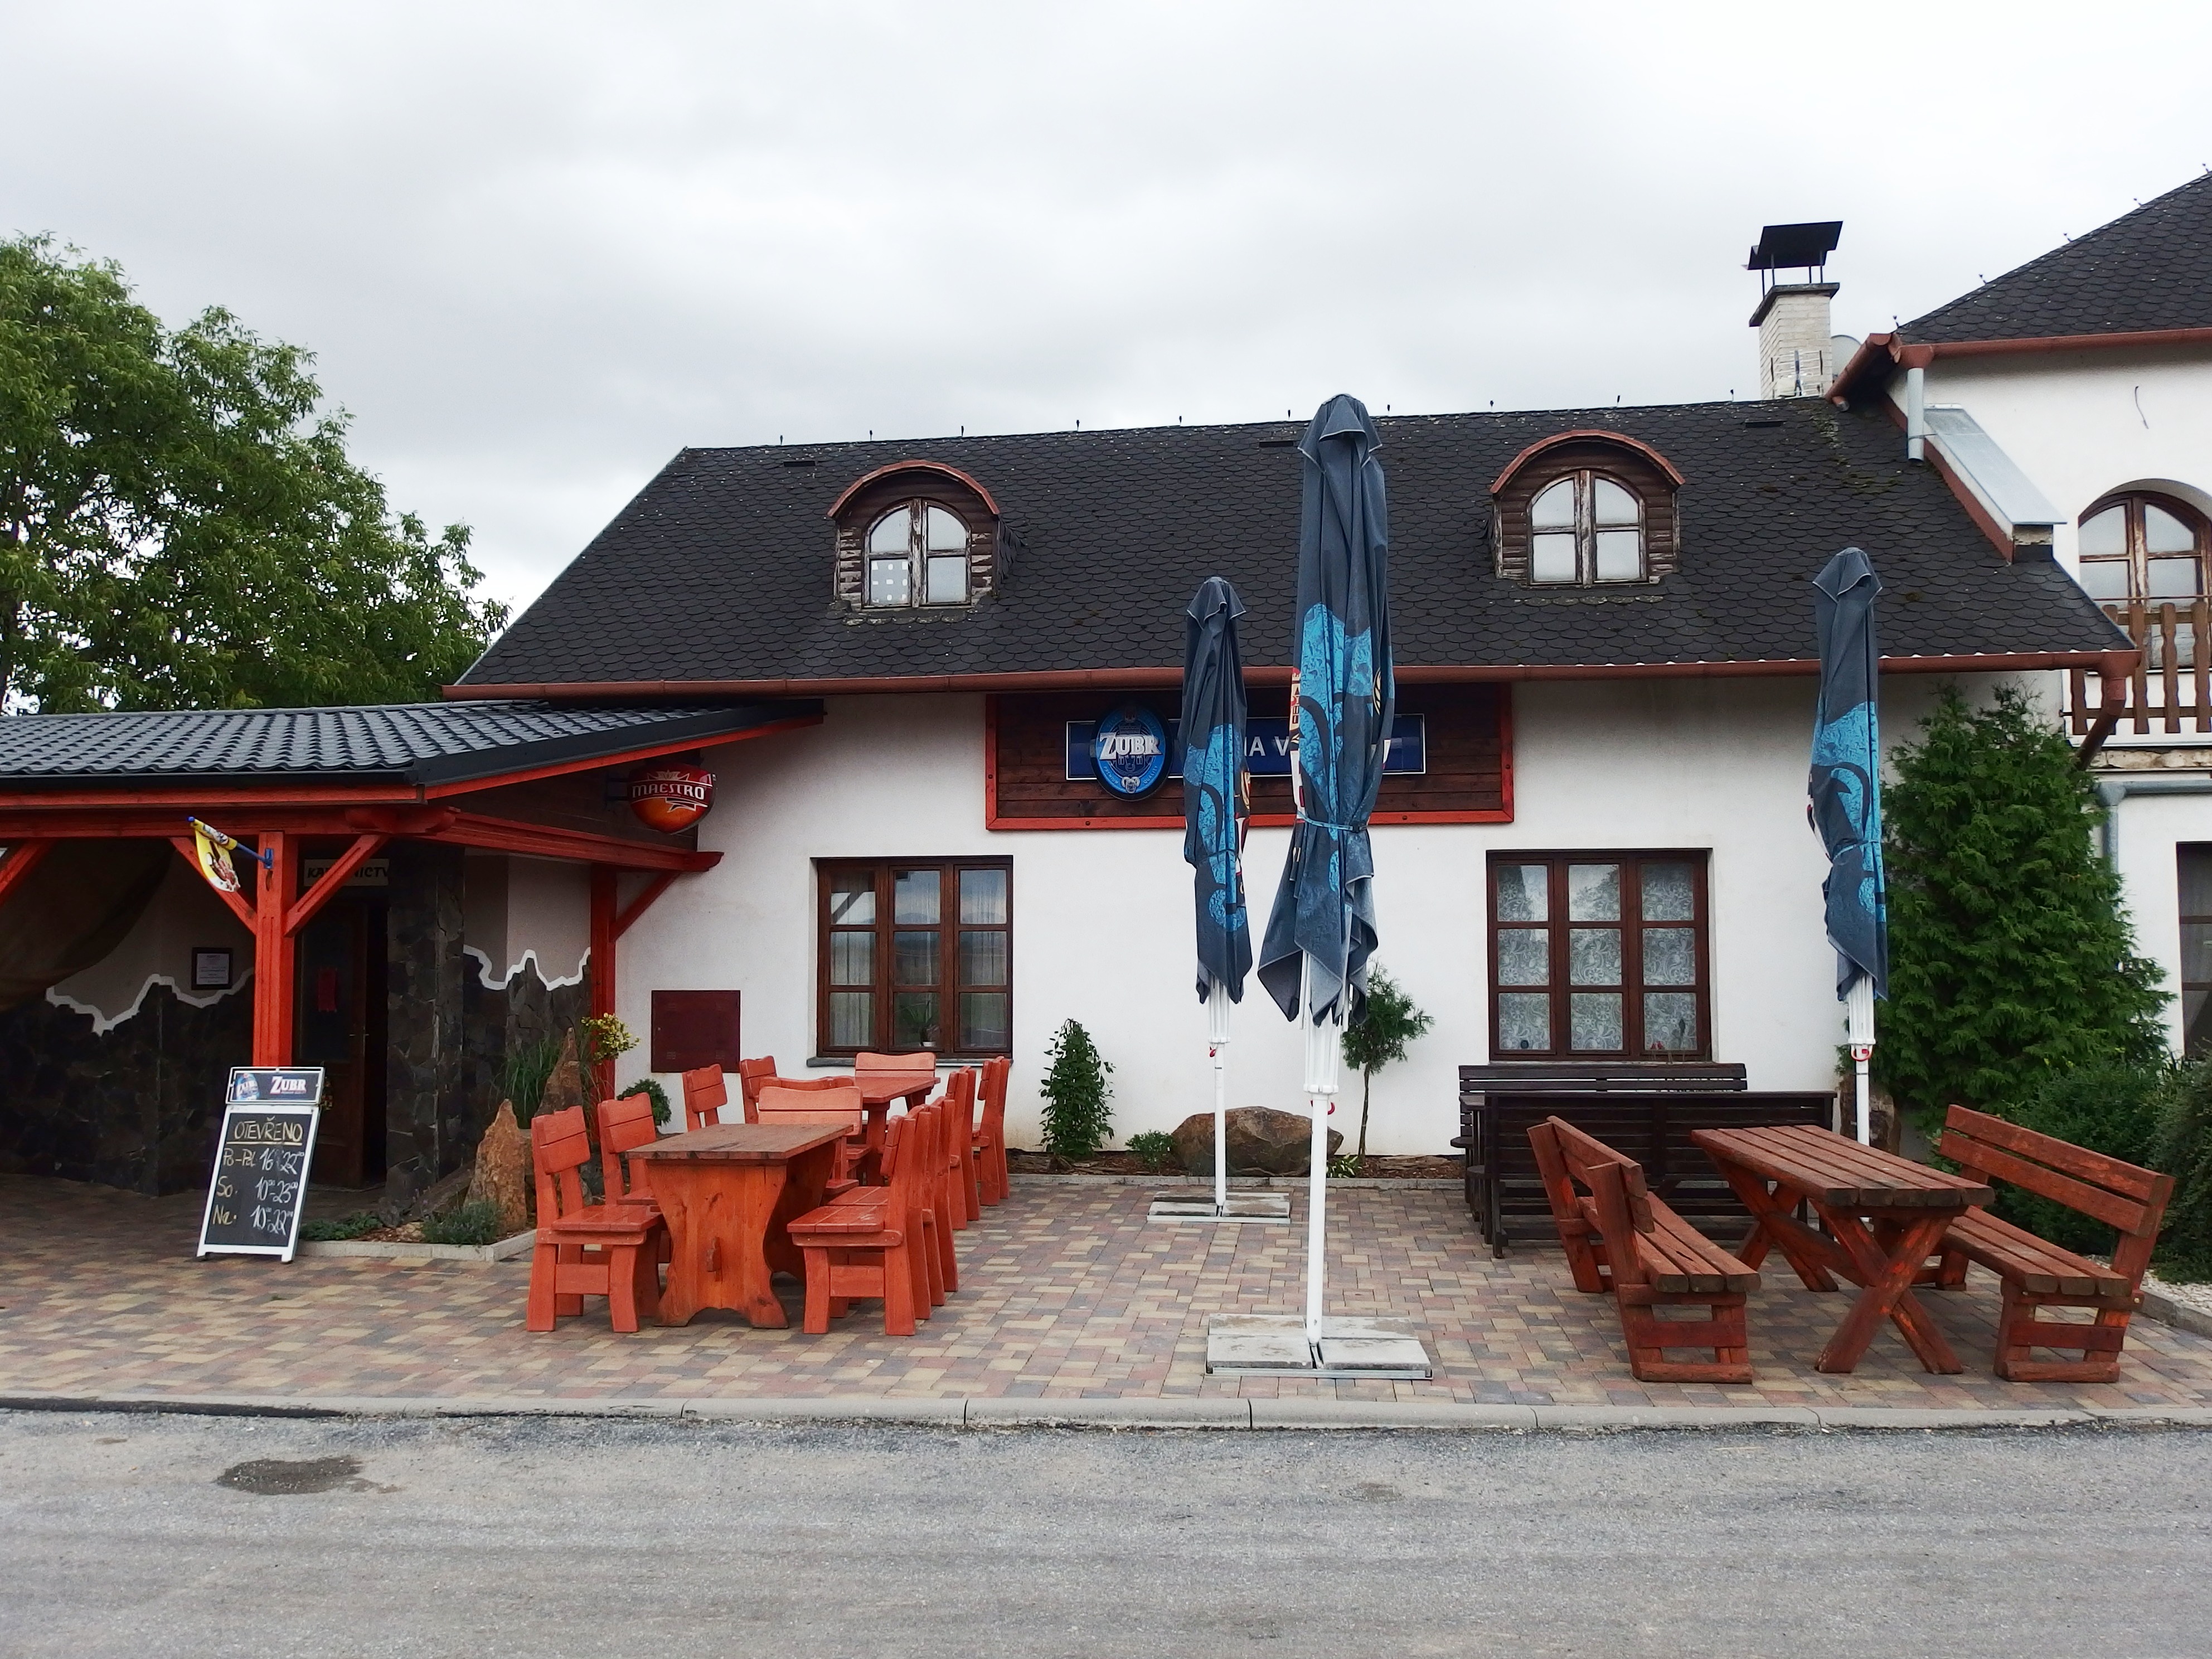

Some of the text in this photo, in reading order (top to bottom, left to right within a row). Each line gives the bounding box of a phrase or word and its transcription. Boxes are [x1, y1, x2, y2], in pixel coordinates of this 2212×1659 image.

[1099, 732, 1163, 760] ZUBR
[632, 783, 705, 800] MAESTRO
[270, 1076, 307, 1094] ZUBR
[234, 1115, 303, 1142] OTEVŘENO
